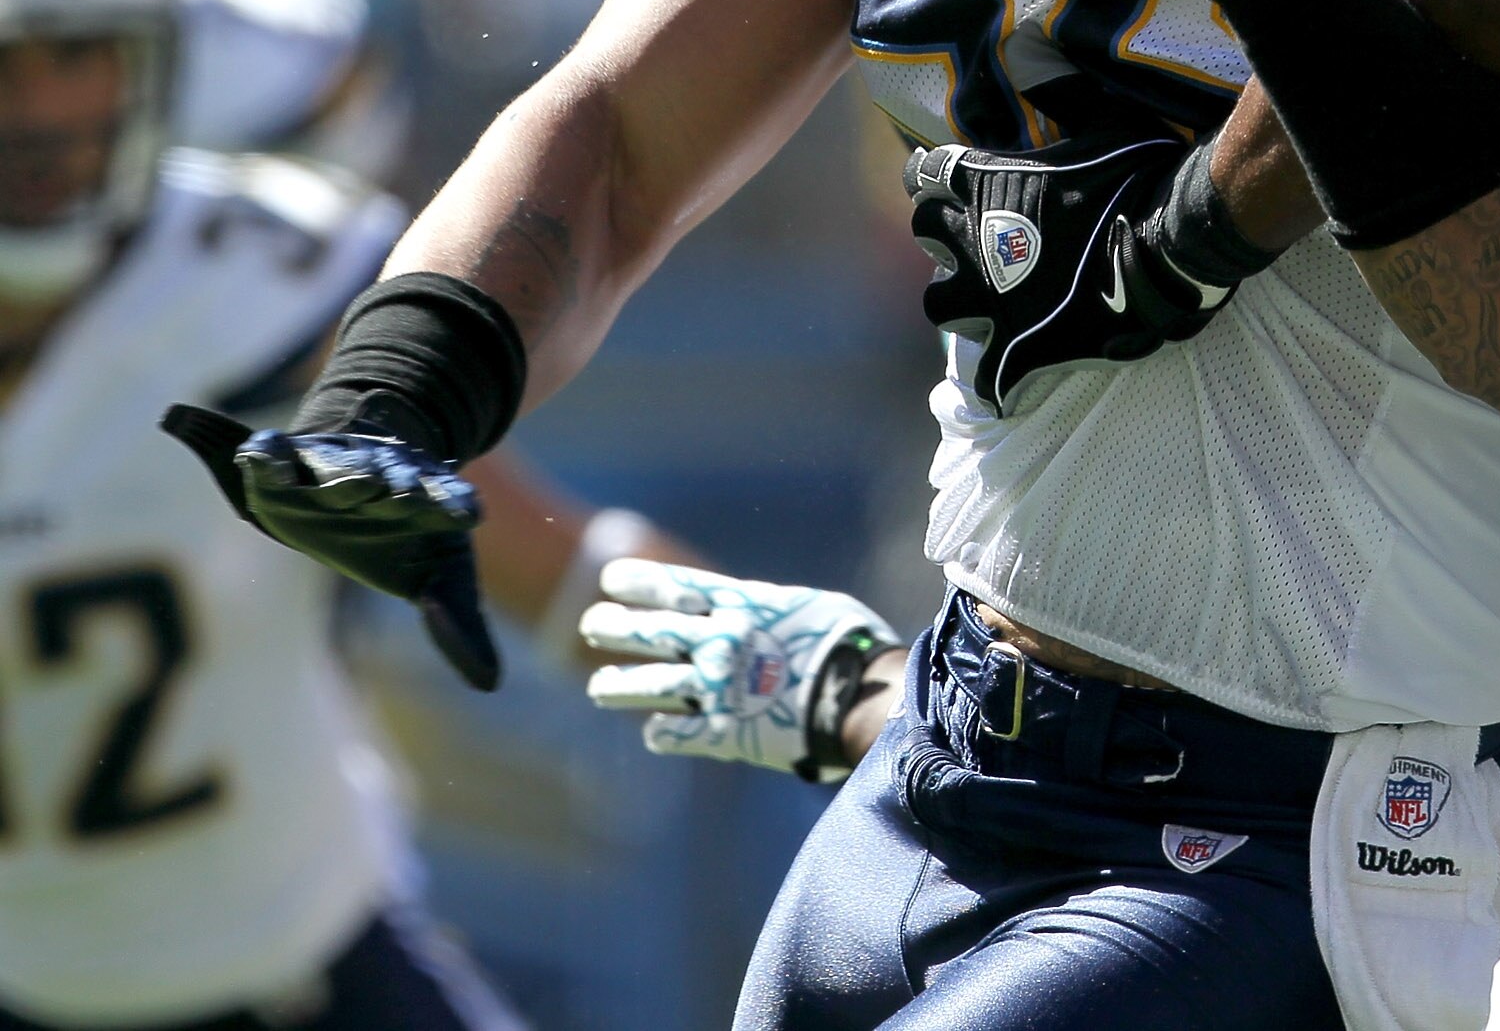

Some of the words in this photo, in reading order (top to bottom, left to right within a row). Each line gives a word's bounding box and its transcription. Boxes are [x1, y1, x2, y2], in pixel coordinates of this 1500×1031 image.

[987, 223, 1007, 282] EQUIPMENT
[1008, 228, 1028, 261] NFL
[1388, 797, 1427, 827] NFL
[1179, 843, 1211, 862] NFL
[1357, 842, 1456, 877] Wilson
